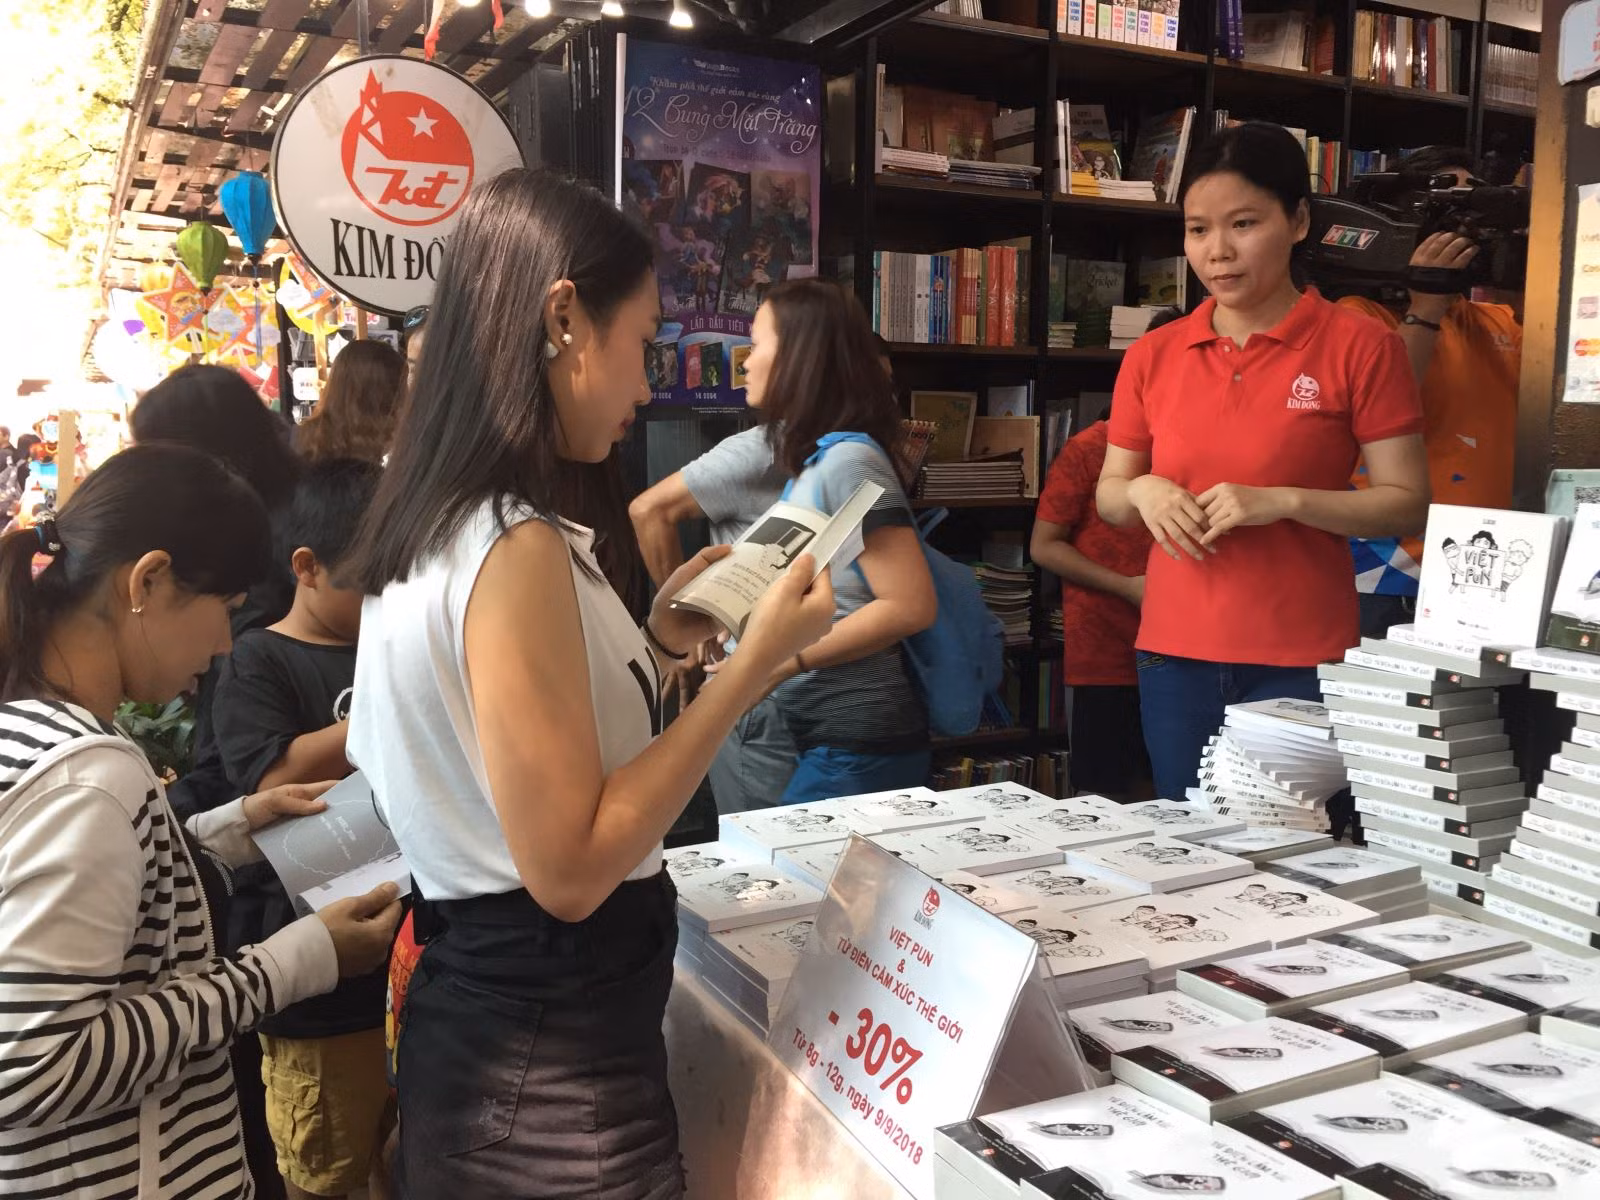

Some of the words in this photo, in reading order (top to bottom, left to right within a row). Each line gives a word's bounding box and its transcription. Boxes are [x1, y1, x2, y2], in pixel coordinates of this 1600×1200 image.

[664, 94, 711, 143] Cung
[713, 101, 763, 145] Mặt
[763, 107, 817, 154] Trăng
[330, 217, 396, 280] KIM
[403, 233, 446, 282] ĐỒ
[1326, 227, 1374, 249] HTV
[889, 925, 912, 950] VIỆT
[910, 940, 934, 968] PUN
[896, 958, 905, 974] &
[836, 936, 851, 956] TỪ
[850, 946, 871, 972] ĐIỂN
[870, 960, 892, 988] CẢM
[892, 977, 915, 1006] XÚC
[915, 995, 938, 1024] THẾ
[936, 1012, 964, 1044] GIỚI
[845, 1007, 924, 1104] 30%
[792, 1027, 807, 1051] Từ
[804, 1041, 820, 1067] 8g
[826, 1062, 845, 1096] 12g,
[846, 1083, 874, 1121] ngày
[874, 1108, 924, 1166] 9/9/2018
